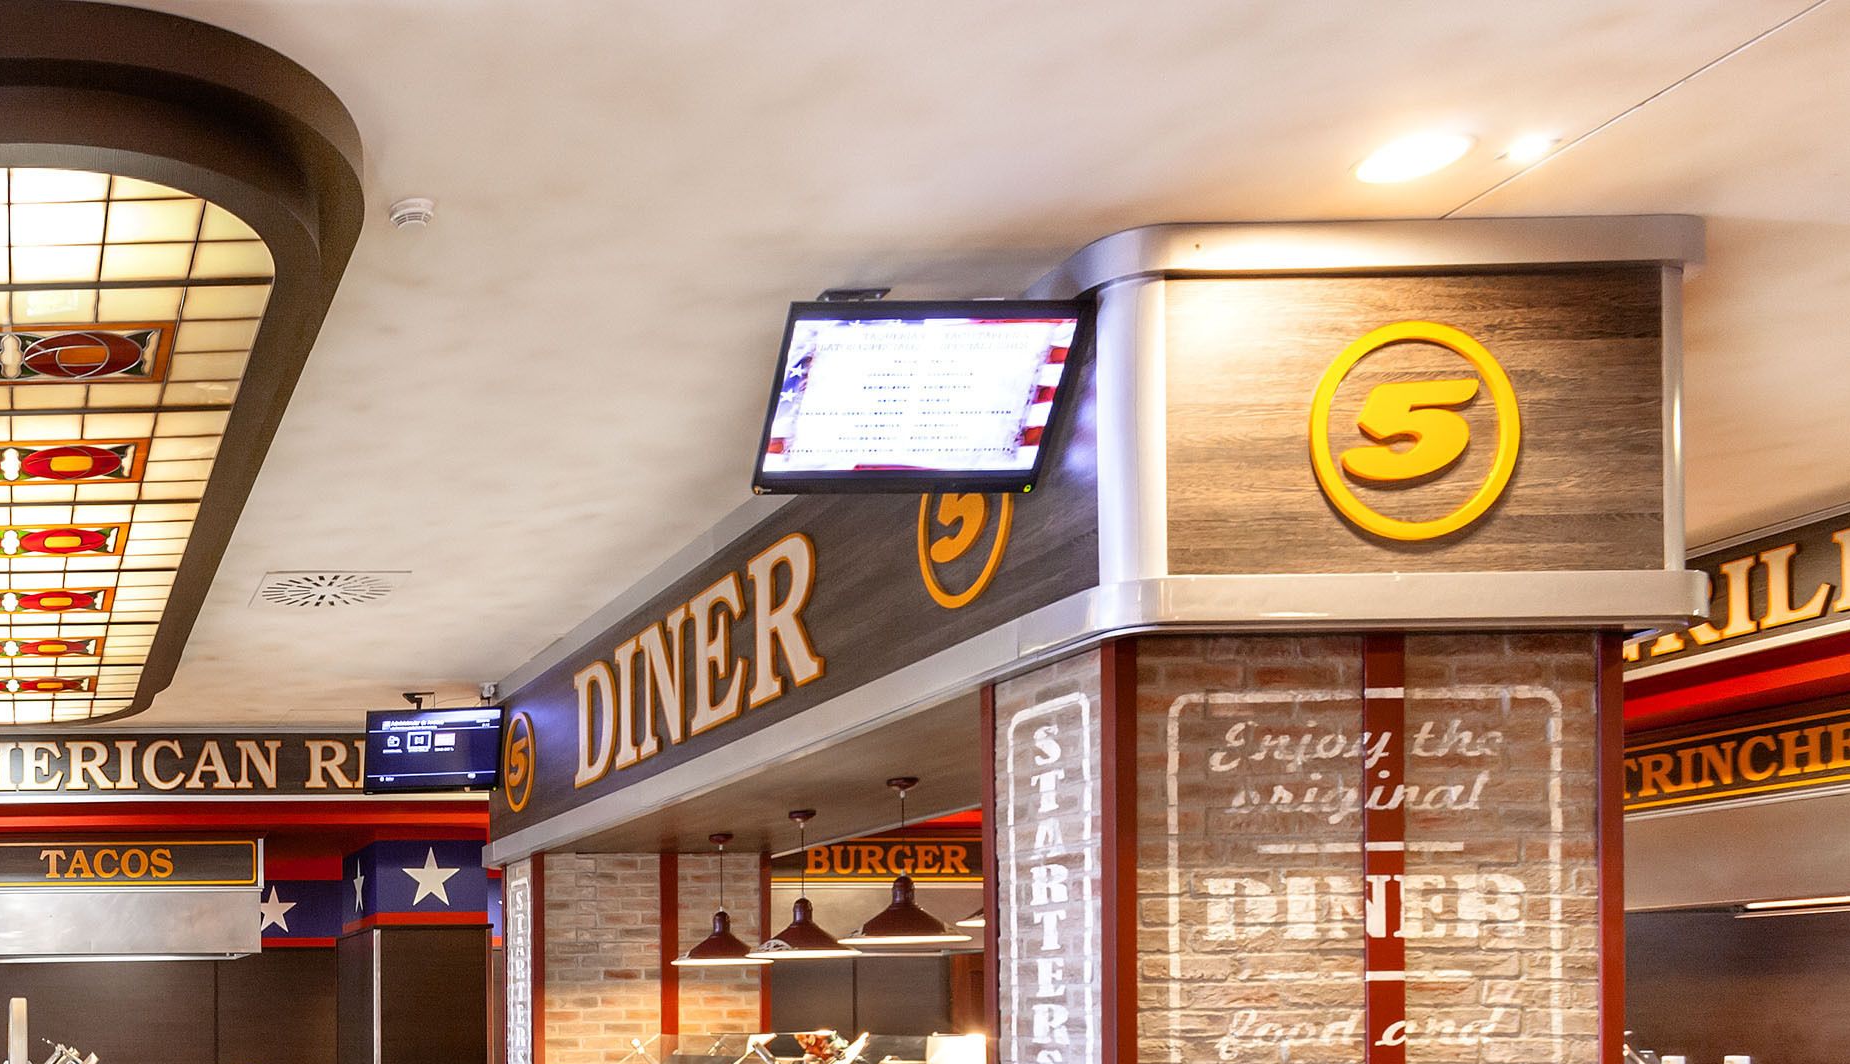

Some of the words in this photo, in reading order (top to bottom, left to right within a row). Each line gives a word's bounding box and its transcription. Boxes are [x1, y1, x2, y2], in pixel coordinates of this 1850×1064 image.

[1340, 377, 1480, 483] 5
[572, 530, 827, 791] DINER
[508, 736, 529, 787] 5
[1210, 718, 1393, 773] Enjoy
[1412, 718, 1505, 758] the
[1224, 769, 1491, 825] original
[39, 848, 175, 880] TACOS
[805, 844, 971, 876] BURGER
[1202, 872, 1529, 942] DINER
[1216, 1008, 1365, 1062] food
[1374, 1004, 1508, 1047] and
